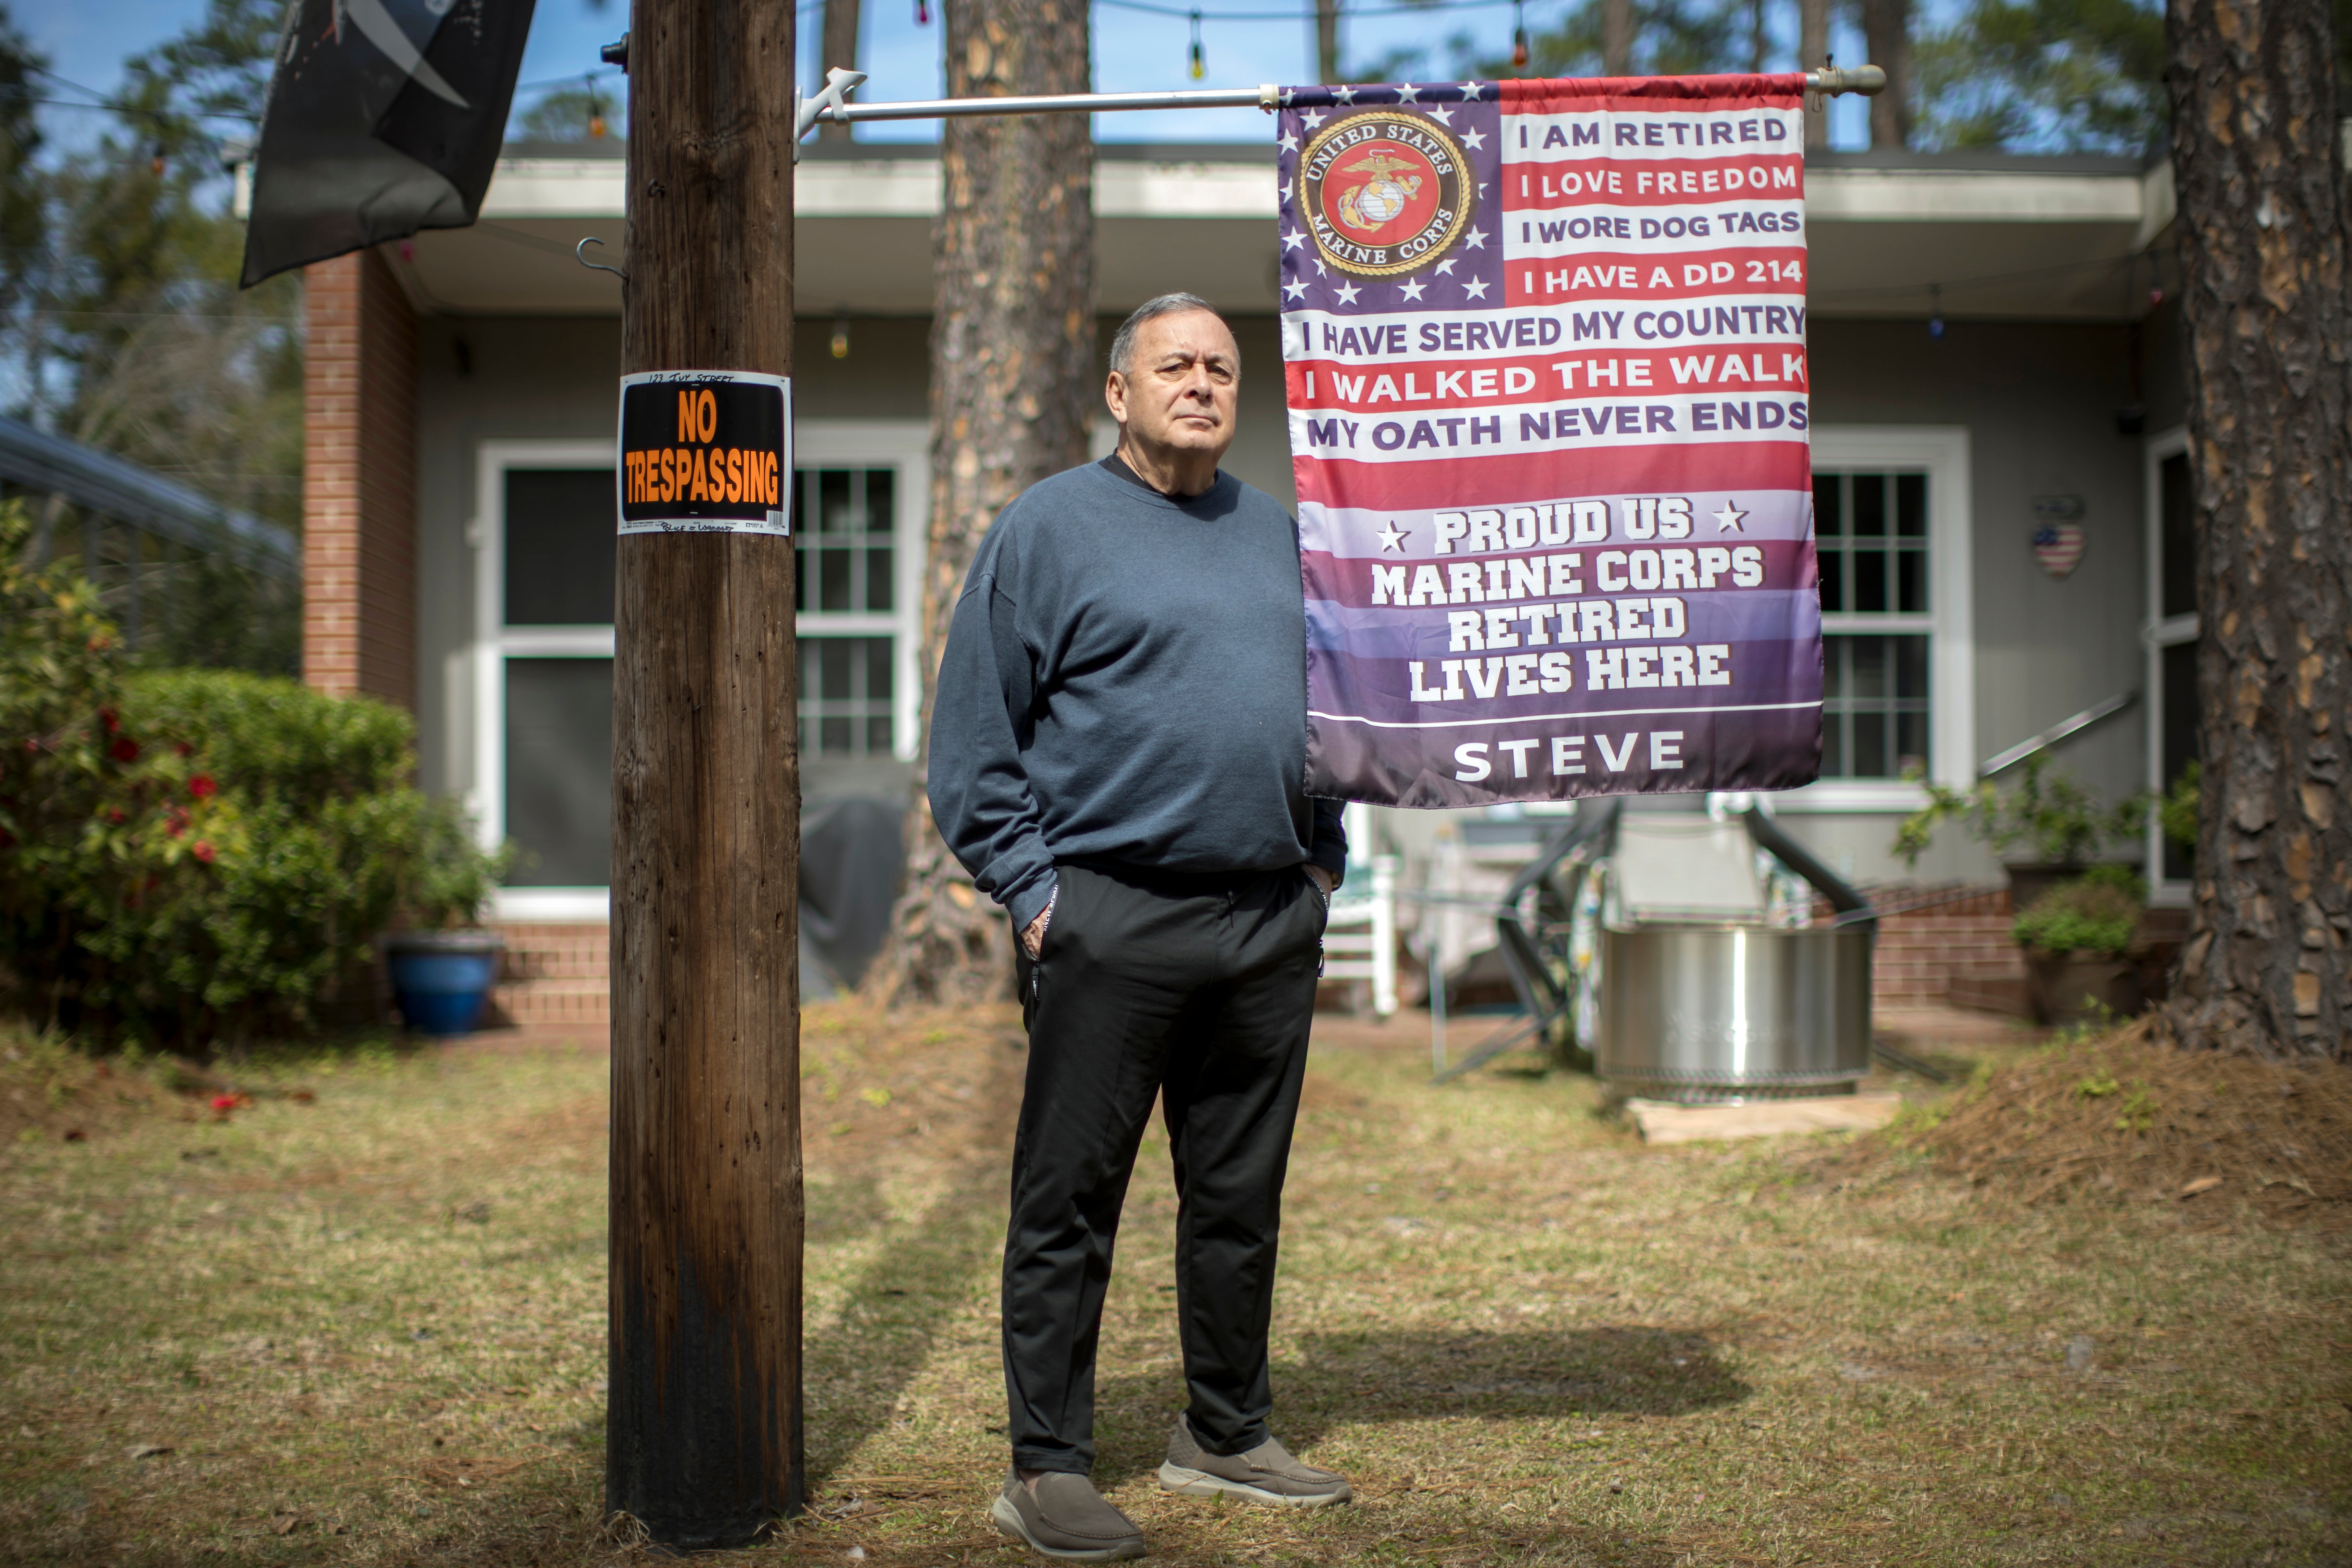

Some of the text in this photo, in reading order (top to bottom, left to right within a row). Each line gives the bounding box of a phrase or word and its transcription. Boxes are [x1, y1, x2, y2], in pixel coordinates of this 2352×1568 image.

[1306, 125, 1453, 181] UNITED STATES
[1520, 118, 1787, 149] I AM RETIRED
[1521, 165, 1796, 198] I LOVE FREEDOM
[1313, 208, 1452, 264] MARINE CORPS
[1523, 211, 1800, 243] I WORE DOG TAGS
[1524, 261, 1802, 293] I HAVE A DD 214
[1304, 305, 1806, 356] I HAVE SERVED MY COUNTRY
[649, 374, 663, 383] 123
[695, 374, 734, 383] STREET
[1306, 353, 1806, 402] I WALKED THE WALK
[679, 390, 716, 443] NO
[1306, 400, 1808, 450] MY OATH NEVER ENDS
[626, 448, 778, 505] TRESPASSING
[661, 522, 686, 531] POLICE
[1433, 497, 1692, 554] PROUD US
[1371, 546, 1764, 606] MARINE CORPS
[1448, 596, 1687, 652] RETIRED
[1409, 644, 1730, 702] LIVES HERE
[1454, 731, 1683, 782] STEVE
